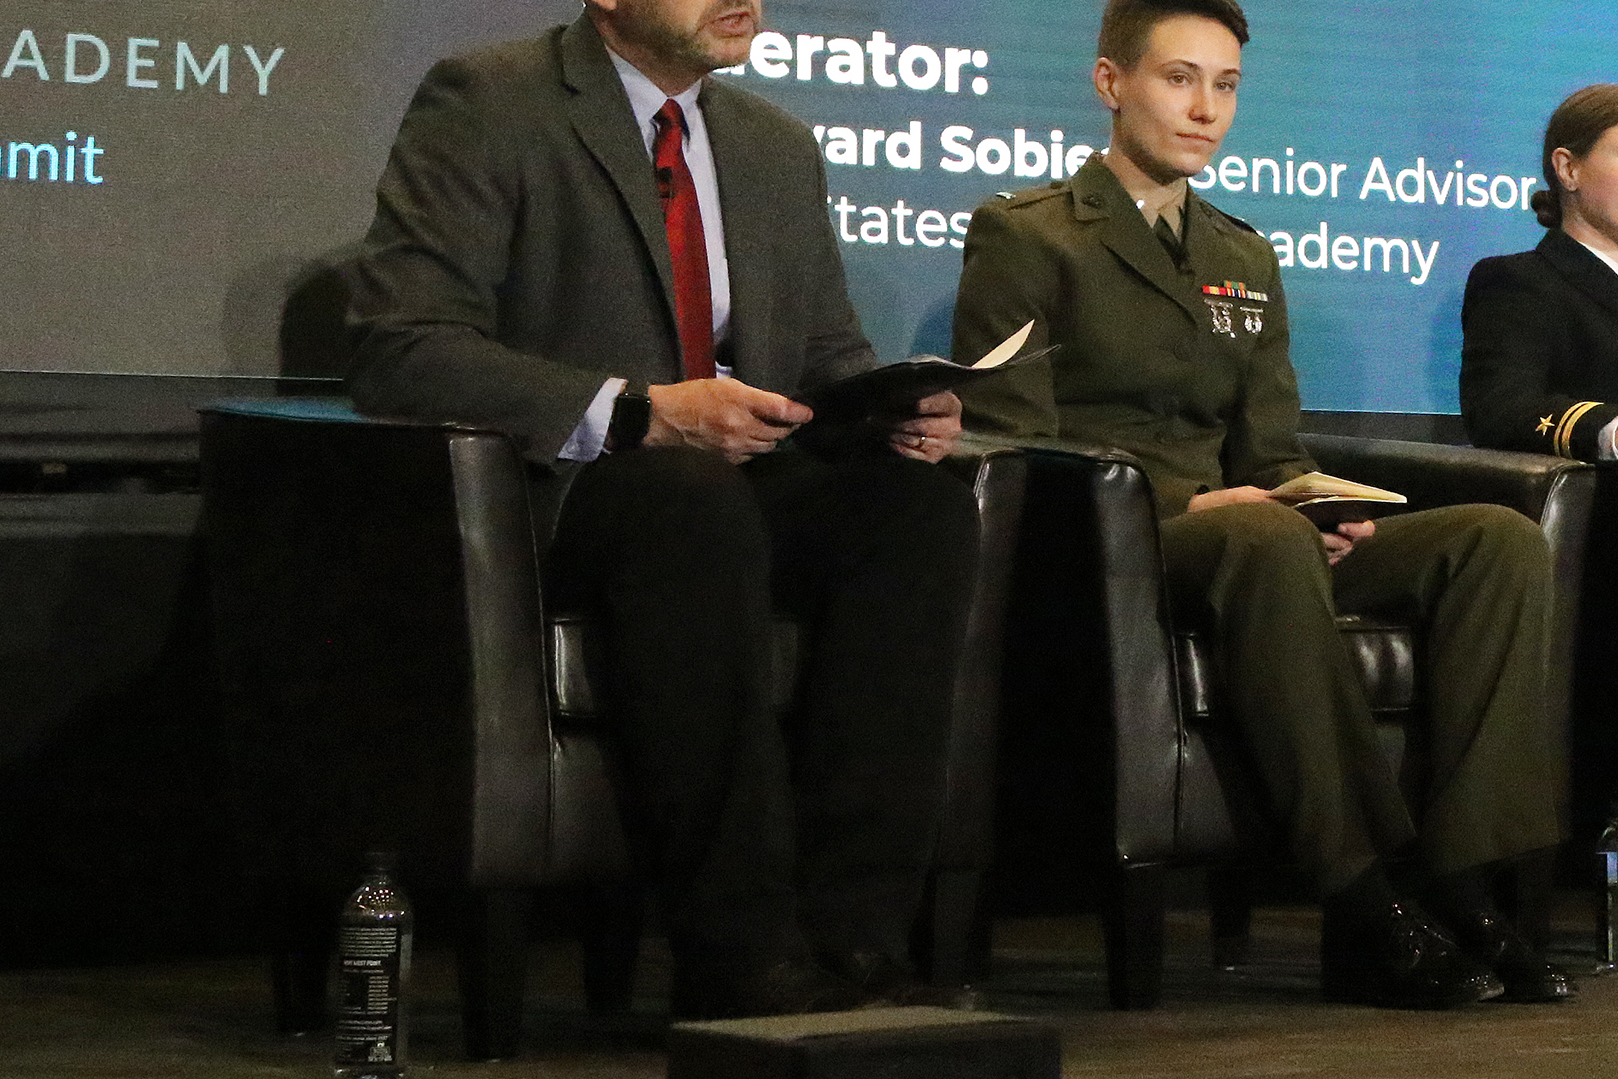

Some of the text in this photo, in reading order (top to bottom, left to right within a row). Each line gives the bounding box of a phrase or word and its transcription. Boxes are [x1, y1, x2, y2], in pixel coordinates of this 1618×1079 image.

[3, 29, 285, 96] ADEMY
[712, 30, 989, 96] erator:
[0, 129, 105, 185] mit
[939, 125, 1110, 180] Sobie
[1358, 156, 1537, 211] Advisor
[827, 195, 1440, 286] tates ademy
